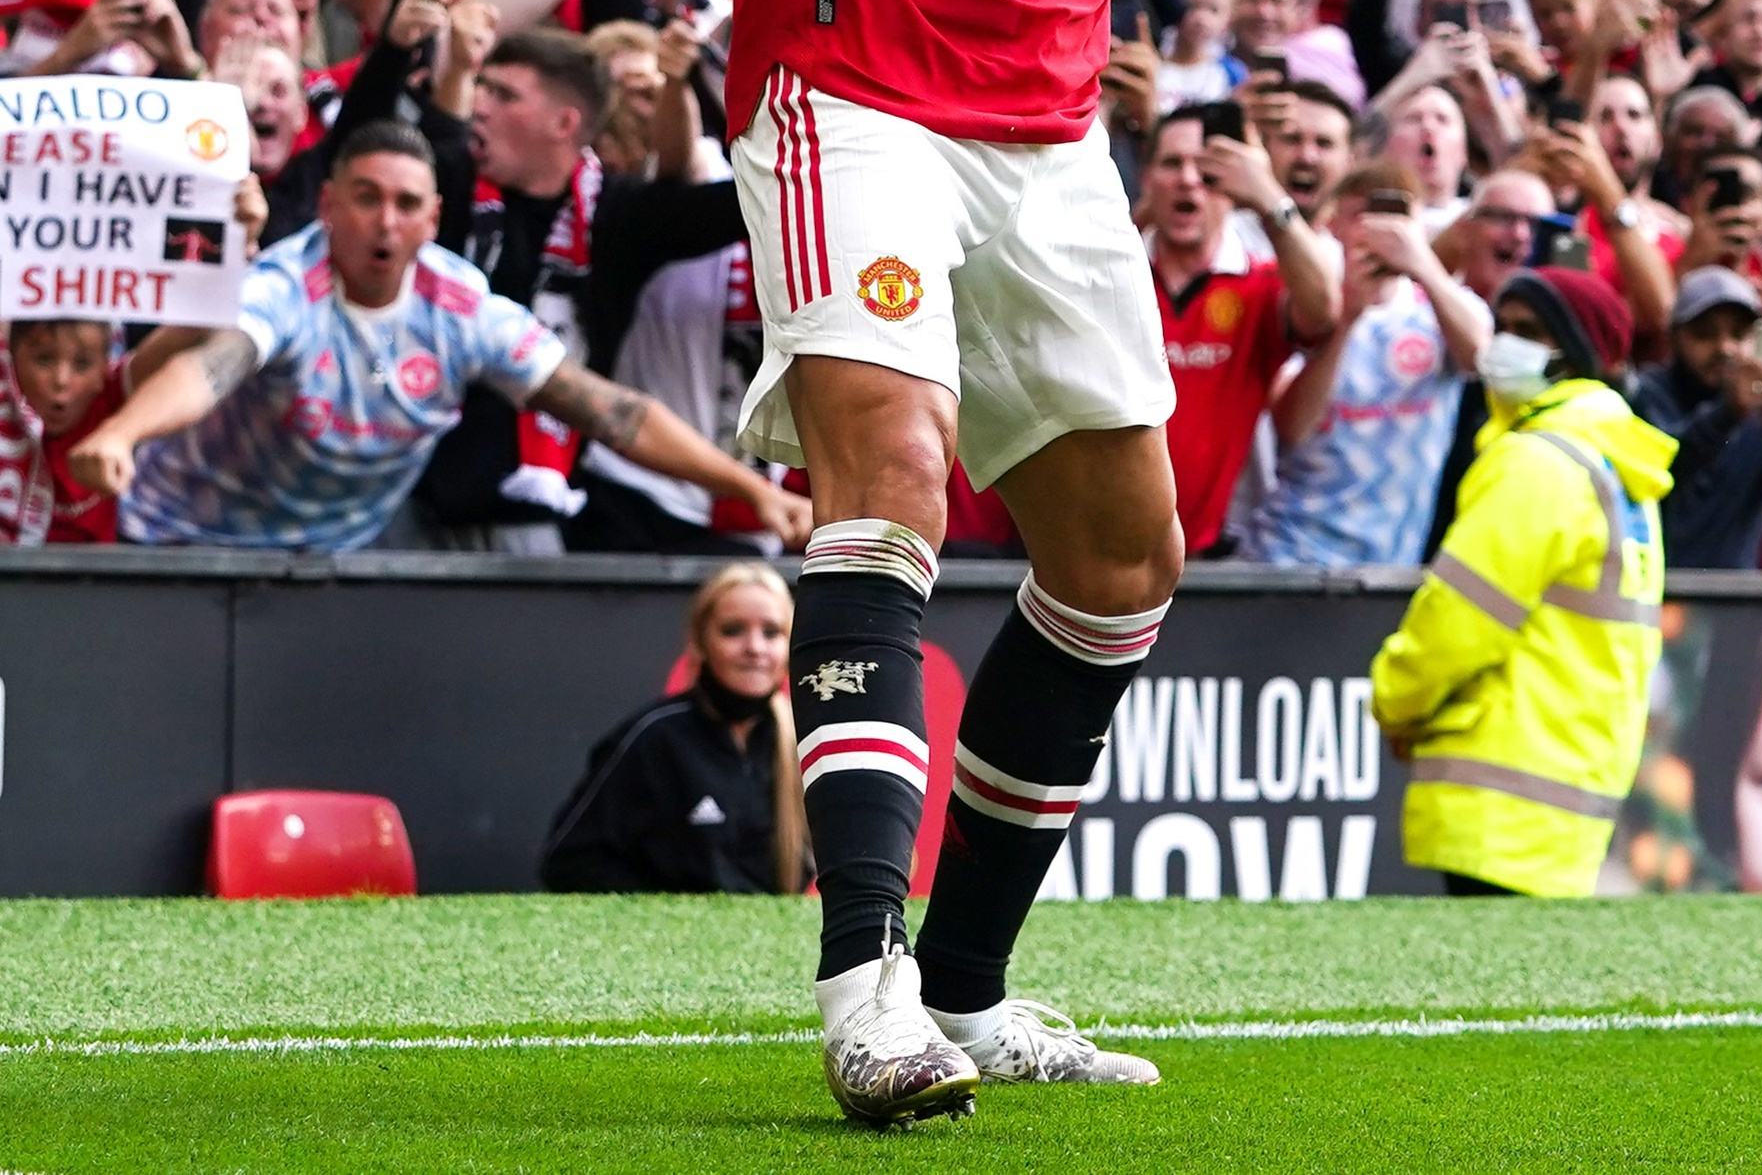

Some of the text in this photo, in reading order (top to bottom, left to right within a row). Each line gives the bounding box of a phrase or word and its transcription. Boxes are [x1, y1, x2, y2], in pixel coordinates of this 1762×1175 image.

[0, 87, 170, 124] NALDO
[5, 131, 122, 166] EASE
[41, 172, 51, 202] I
[75, 172, 195, 208] HAVE
[8, 215, 134, 250] YOUR
[20, 267, 176, 312] SHIRT
